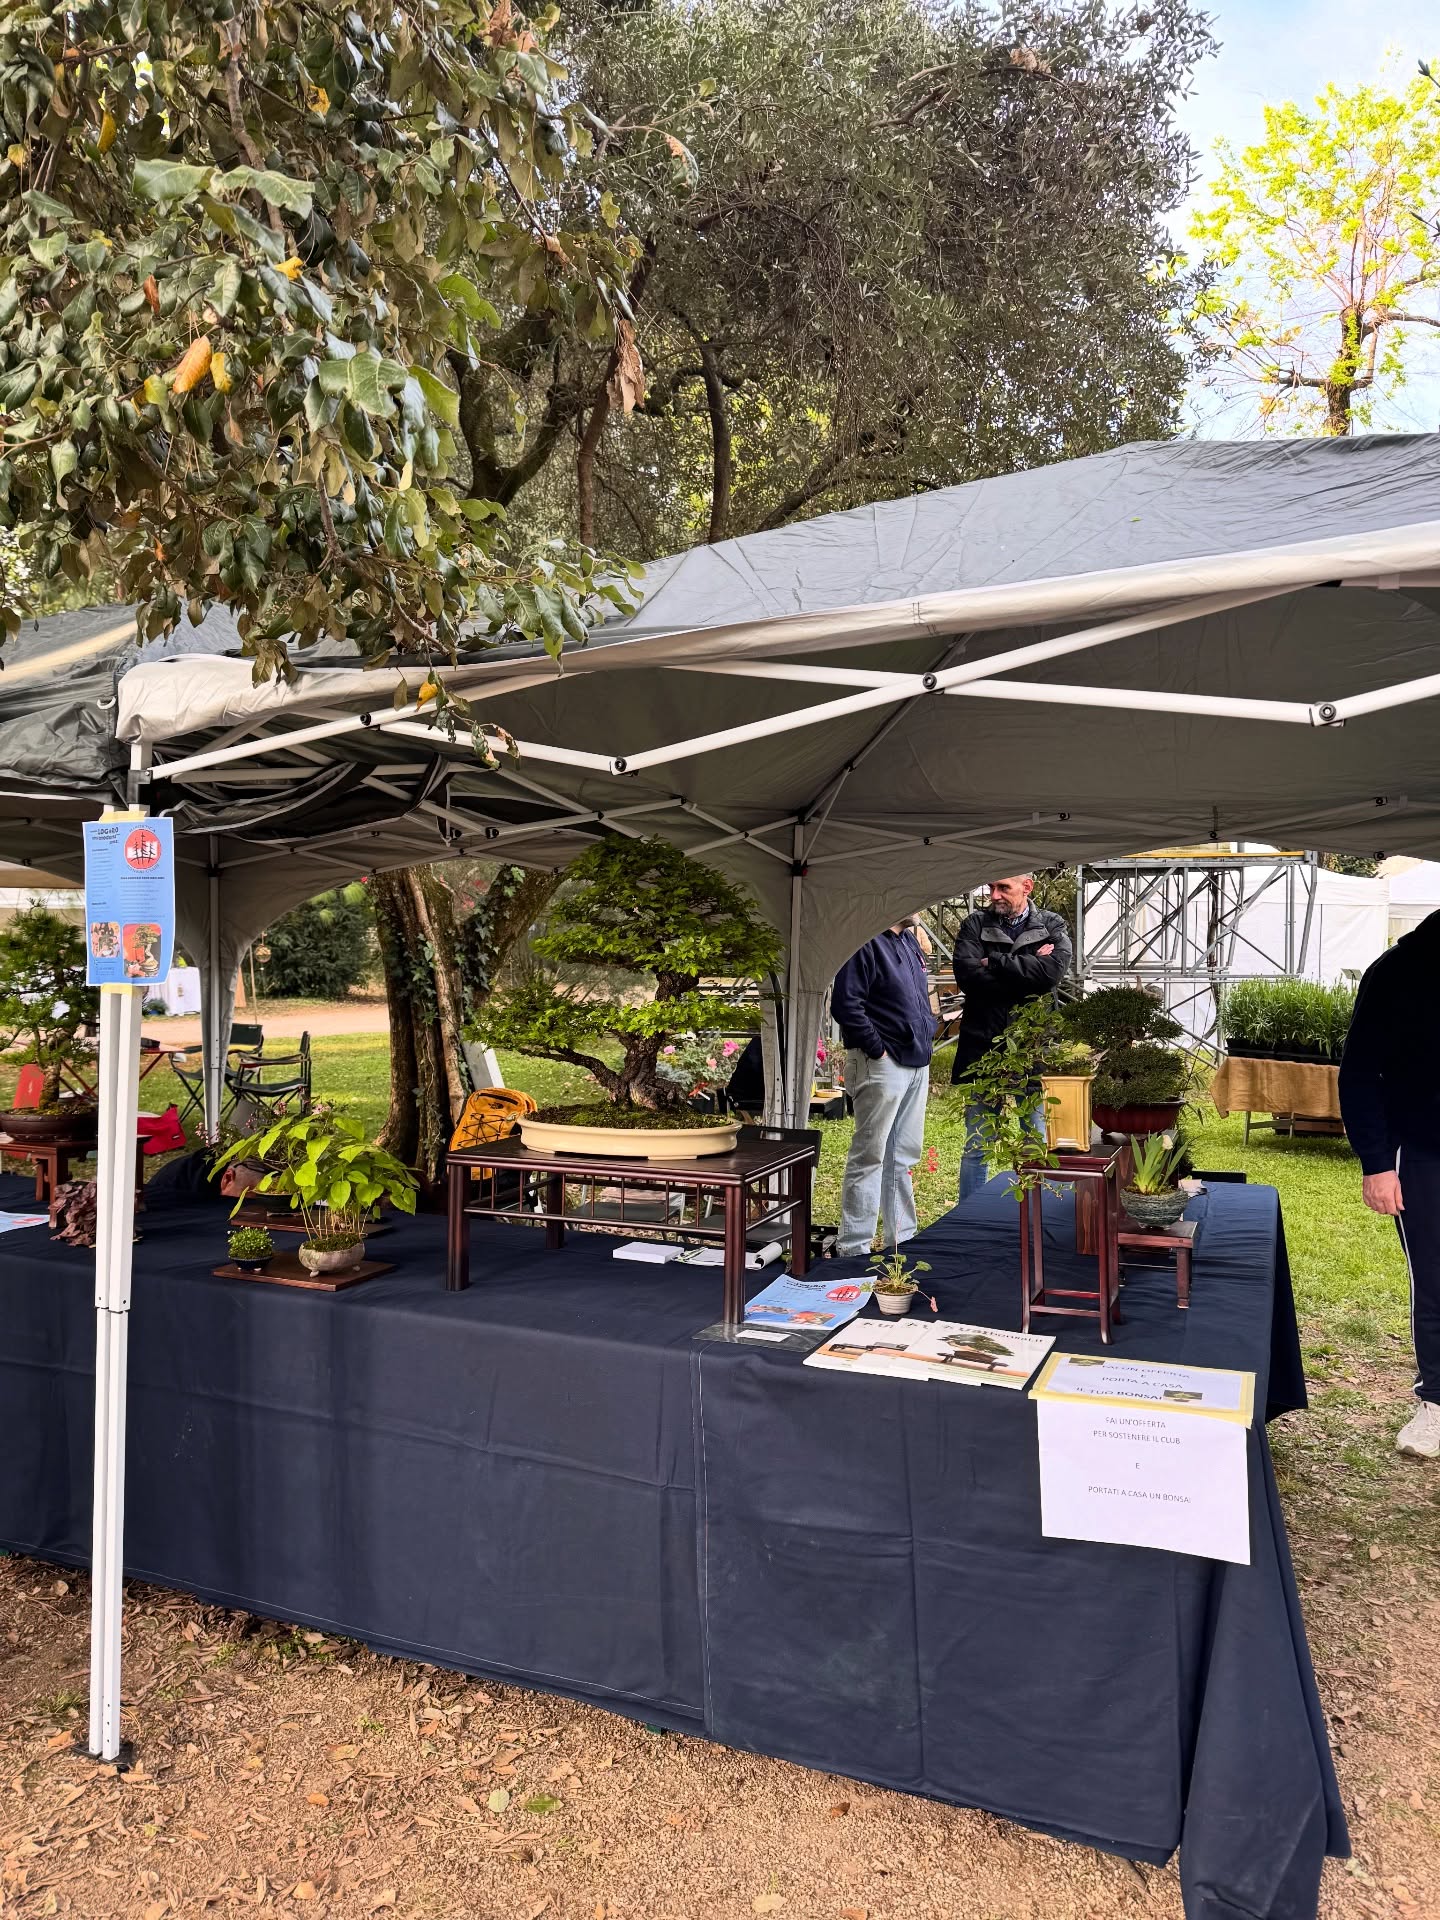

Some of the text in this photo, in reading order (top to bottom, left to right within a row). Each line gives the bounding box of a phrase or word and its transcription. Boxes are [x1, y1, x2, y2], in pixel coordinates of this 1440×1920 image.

[1152, 1381, 1183, 1389] CASA
[1117, 1391, 1163, 1400] BONSAI
[1105, 1416, 1166, 1428] FAI UN'OFFERTA
[1093, 1430, 1181, 1445] PER SOSTENERE IL CLUB
[1135, 1462, 1140, 1470] E
[1088, 1485, 1120, 1495] PORTATI
[1128, 1490, 1147, 1498] CASA
[1149, 1492, 1161, 1500] UN
